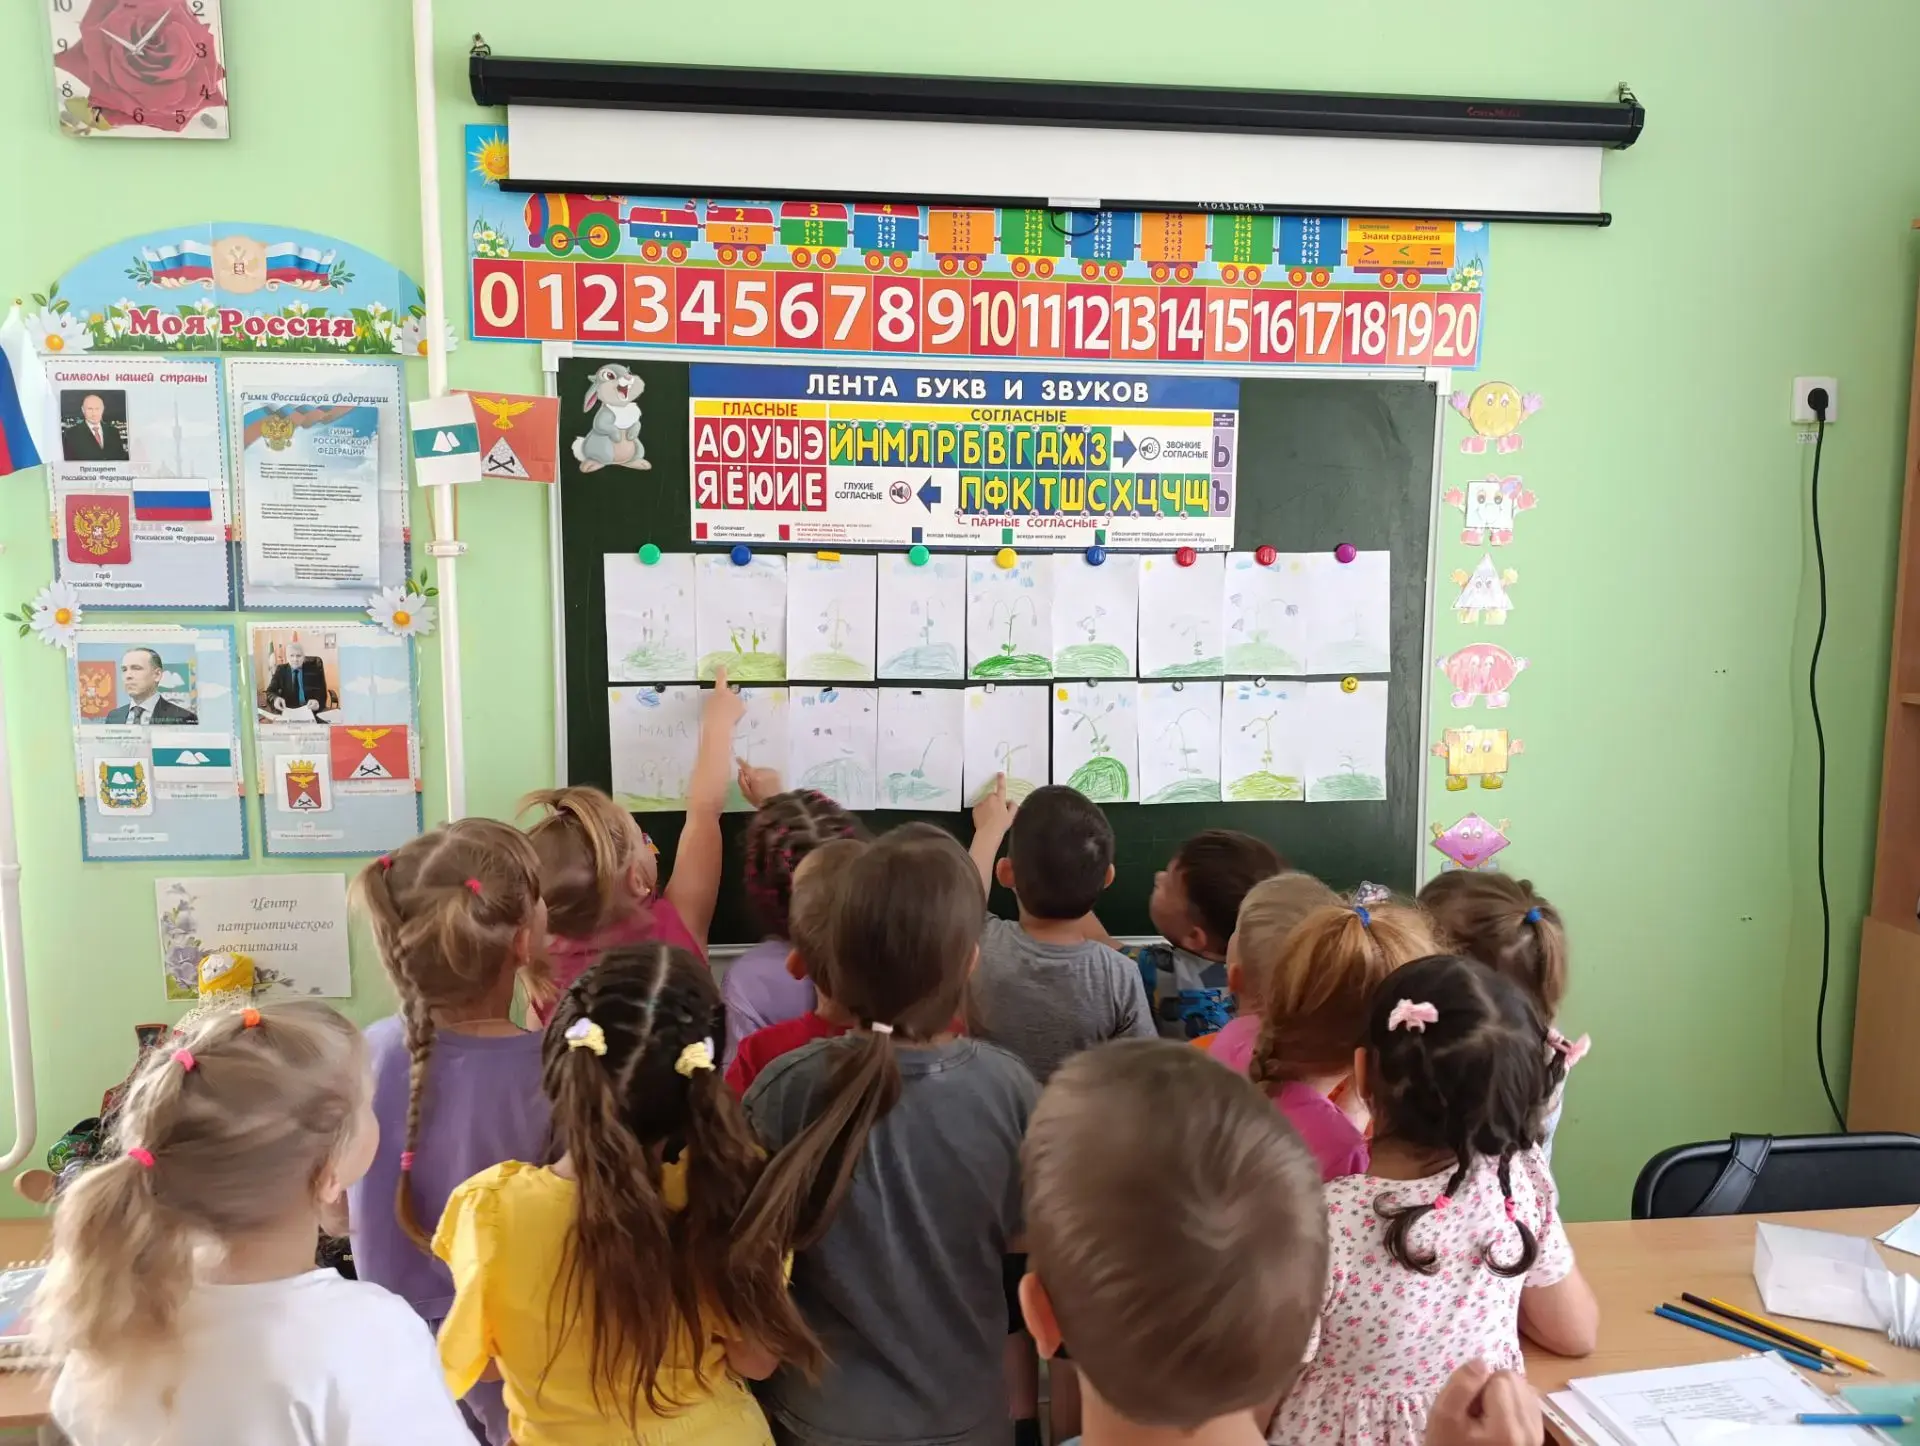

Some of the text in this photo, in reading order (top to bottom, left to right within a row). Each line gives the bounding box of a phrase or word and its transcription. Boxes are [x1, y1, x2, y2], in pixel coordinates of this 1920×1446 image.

[54, 0, 204, 16] 10 2
[57, 38, 207, 58] 9 3
[62, 81, 211, 100] 8 4
[92, 107, 186, 125] 7 6 5
[660, 204, 892, 222] 1 2 3 4
[1362, 232, 1440, 242] Знаки сравнения
[480, 271, 1477, 357] 0 1 2 3 4 5 6 7 8 9 10 11 12 13 14 15 16 17 18 19 20
[127, 309, 355, 338] Моя Россия
[55, 371, 208, 385] Символы нашей страны
[806, 374, 1149, 403] ЛЕНТА БУКВ И ЗВУКОВ
[240, 392, 389, 404] Гимн Российской Федерации
[722, 402, 1067, 423] ГЛАСНЫЕ СОГЛАСНЫЕ
[330, 428, 352, 436] ГИМН
[313, 437, 369, 446] РОССИЙСКОЙ
[696, 422, 1107, 466] А О У Ы Э Й Н М Л Р Б В Г Д Ж З
[1166, 441, 1202, 449] ЗВОНКИЕ
[317, 447, 365, 456] ФЕДЕРАЦИИ
[1162, 450, 1208, 458] СОГЛАСНЫЕ
[698, 465, 1209, 512] Я Ё Ю И Е П Ф К Т Ш С Х Ц Ч Щ
[844, 482, 874, 491] ГЛУХИЕ
[834, 491, 883, 500] СОГЛАСНЫЕ
[971, 517, 1098, 529] ПАРНЫЕ СОГЛАСНЫЕ
[251, 897, 298, 913] Центр
[217, 920, 334, 934] патриотического
[219, 942, 298, 953] воспитания
